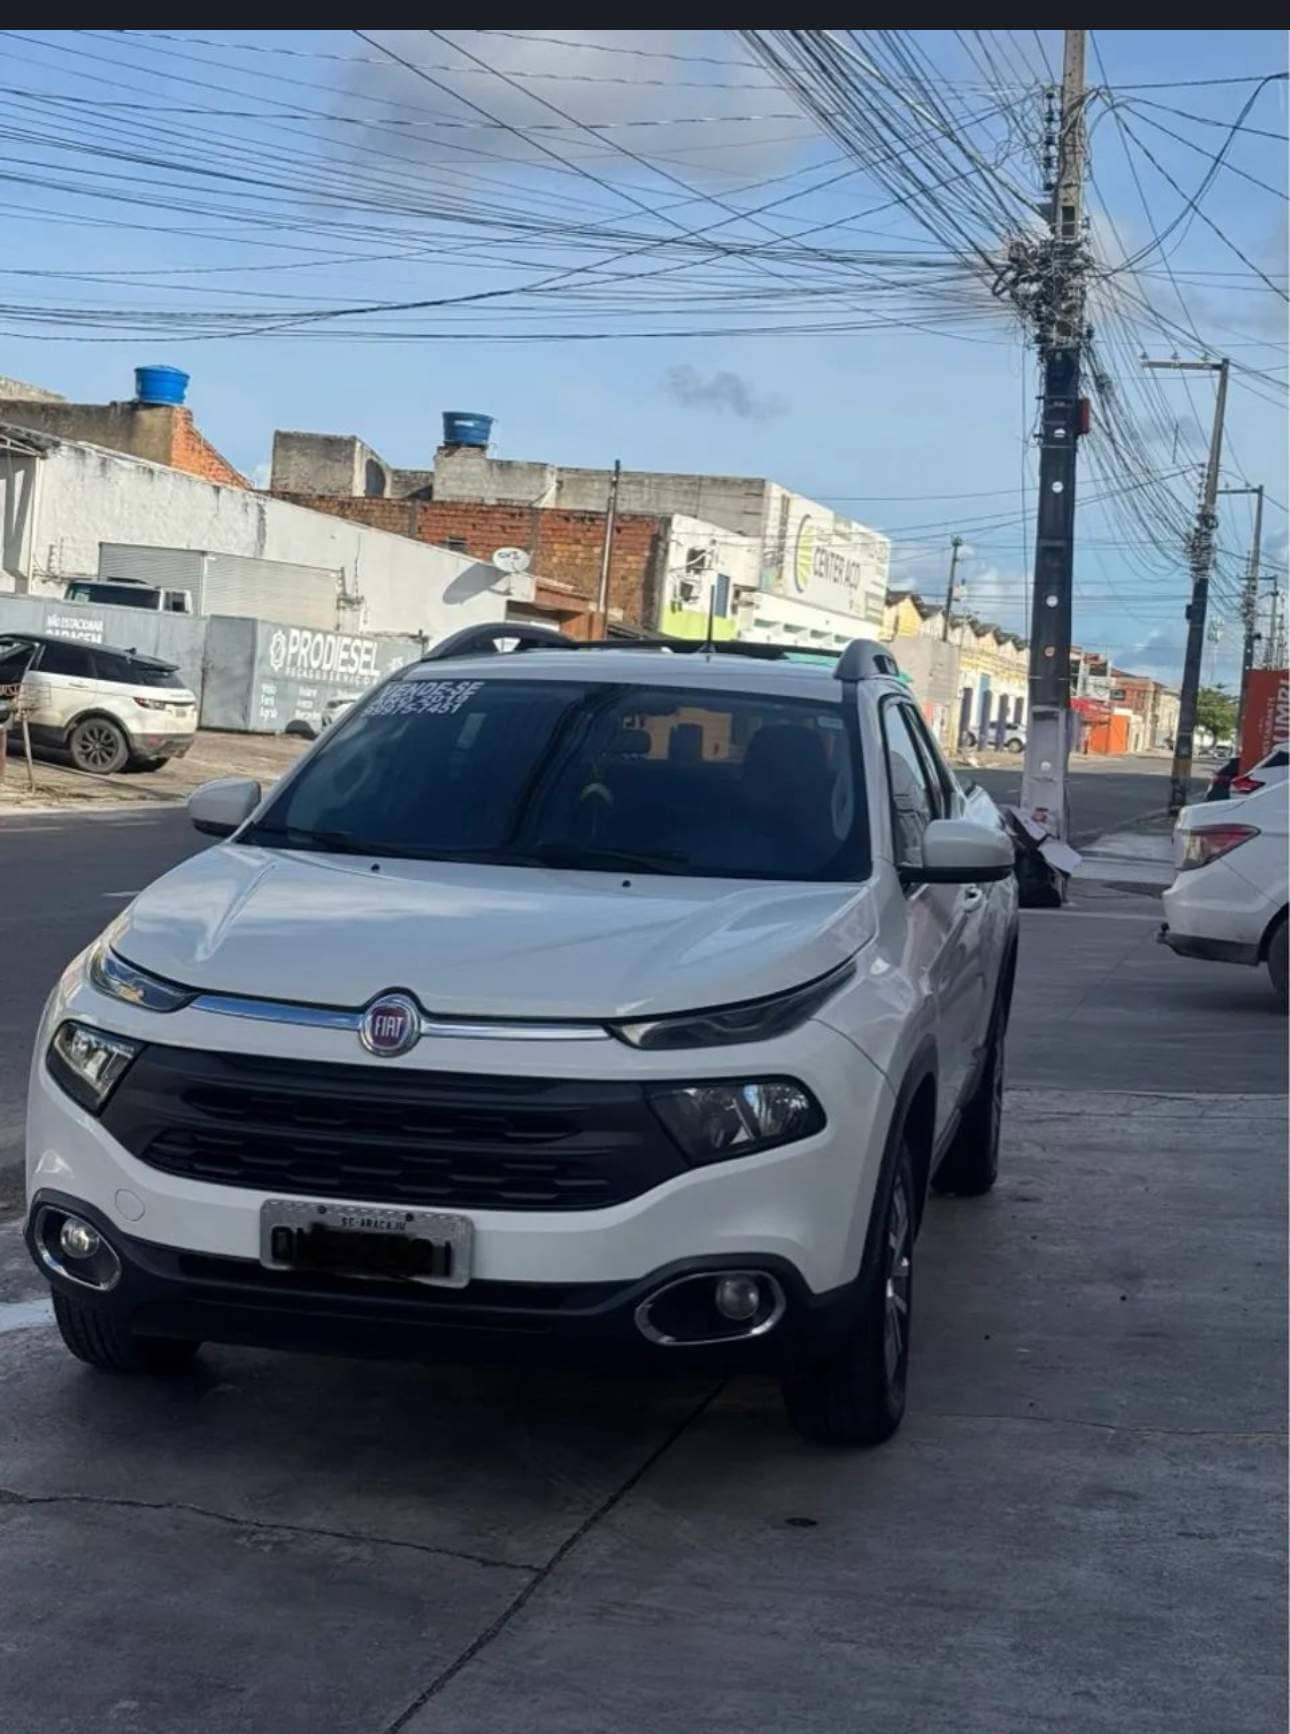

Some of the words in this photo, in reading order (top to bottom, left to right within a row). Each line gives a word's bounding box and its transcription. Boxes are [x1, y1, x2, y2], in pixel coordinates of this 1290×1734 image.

[286, 628, 380, 677] PRODIESEL
[381, 681, 484, 697] VENDE-SE
[375, 1015, 404, 1038] FIAT
